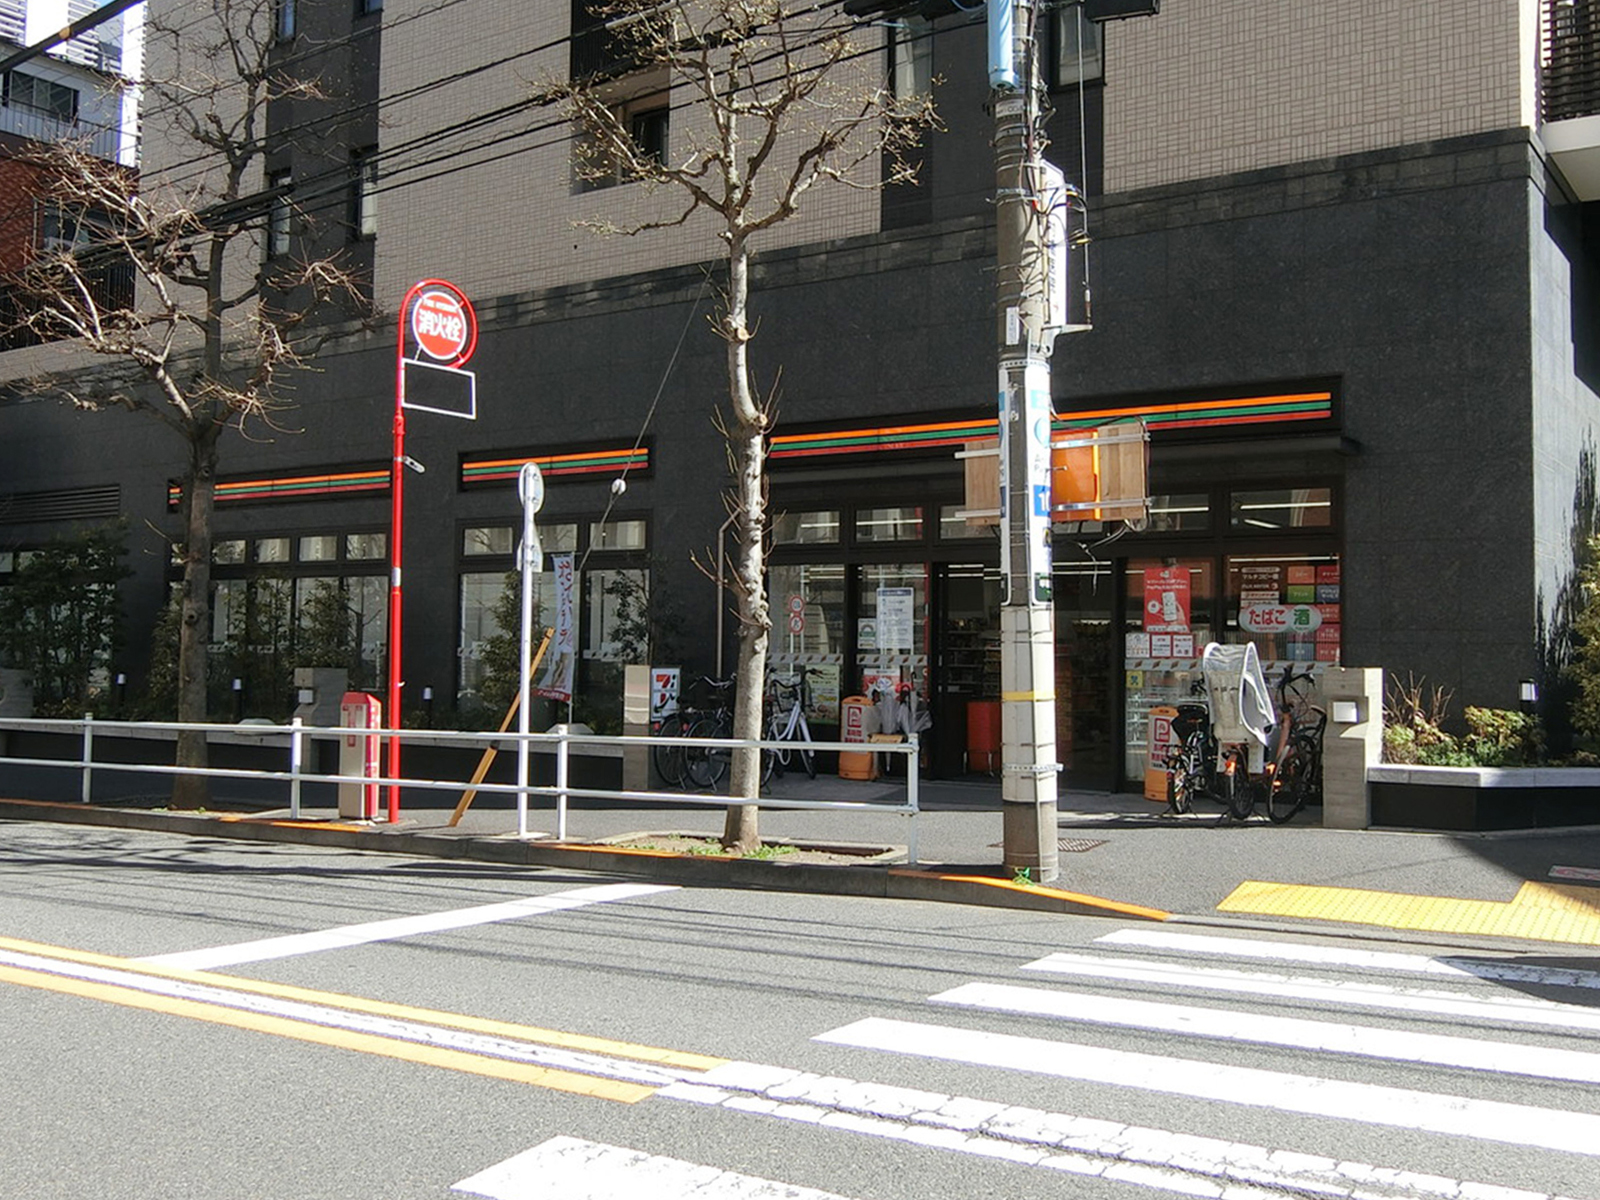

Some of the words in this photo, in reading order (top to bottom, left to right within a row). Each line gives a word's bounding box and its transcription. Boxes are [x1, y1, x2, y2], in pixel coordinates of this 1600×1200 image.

[418, 308, 462, 343] 消火栓
[1248, 608, 1287, 626] たばこ
[1293, 608, 1311, 626] 酒
